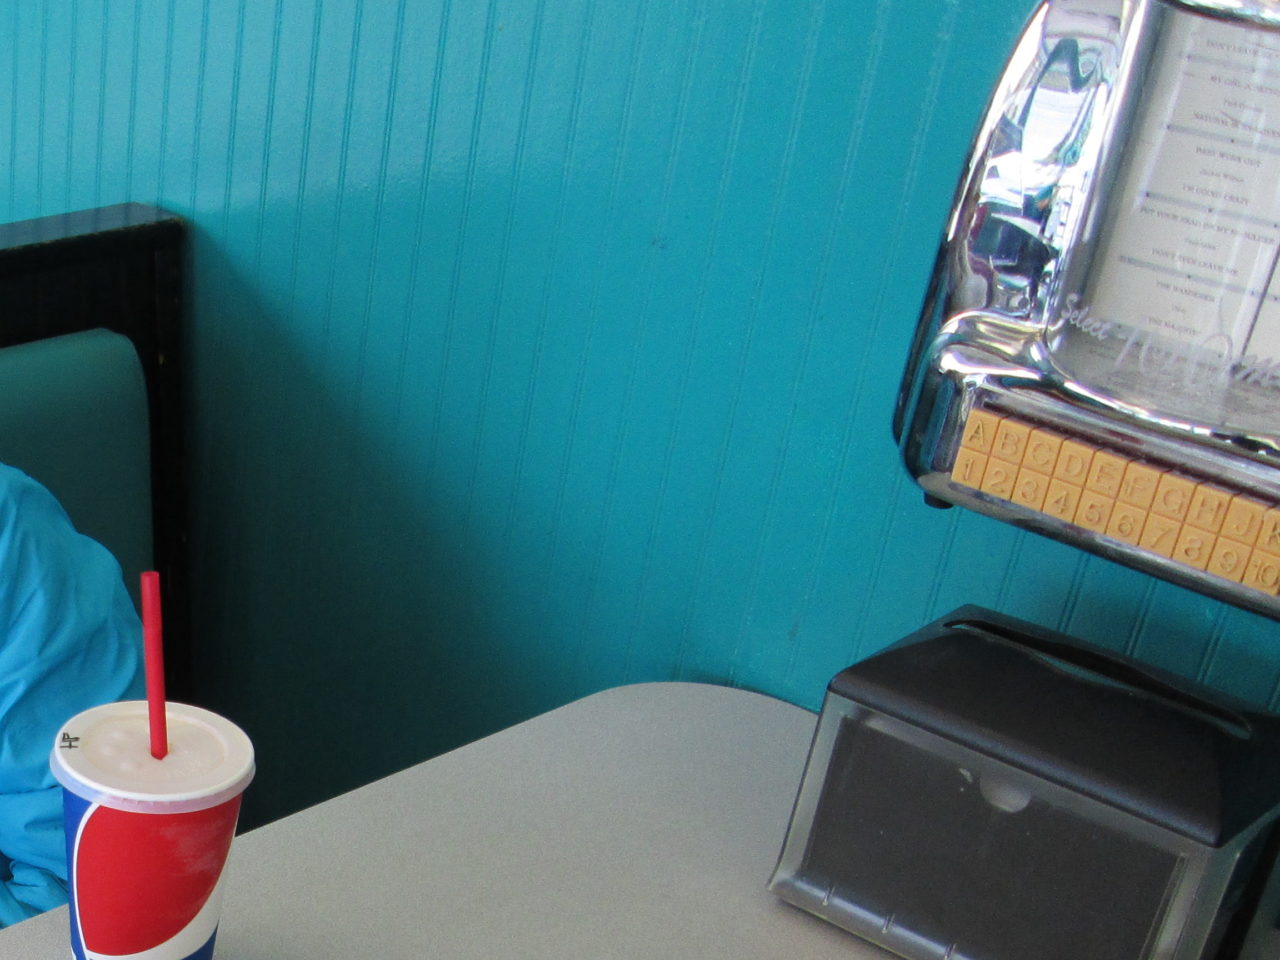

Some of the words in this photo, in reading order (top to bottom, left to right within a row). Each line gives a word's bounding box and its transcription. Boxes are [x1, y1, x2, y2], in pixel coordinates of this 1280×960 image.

[1061, 292, 1112, 340] Select
[963, 458, 975, 482] 1
[990, 469, 1006, 493] 2
[1019, 479, 1038, 502] 3
[1053, 490, 1069, 514] 4
[1085, 503, 1102, 524] 5
[1117, 514, 1135, 538] 6
[1150, 525, 1173, 550] 7
[1184, 538, 1203, 561] 8
[1219, 549, 1238, 573] 9
[1252, 561, 1280, 588] 10
[967, 422, 986, 444] A
[1000, 431, 1019, 457] B
[1030, 442, 1052, 465] C
[1064, 456, 1084, 477] D
[1095, 461, 1116, 490] E
[1125, 474, 1151, 499] F
[1162, 487, 1185, 514] G
[1195, 497, 1223, 526] H
[1235, 512, 1254, 537] J
